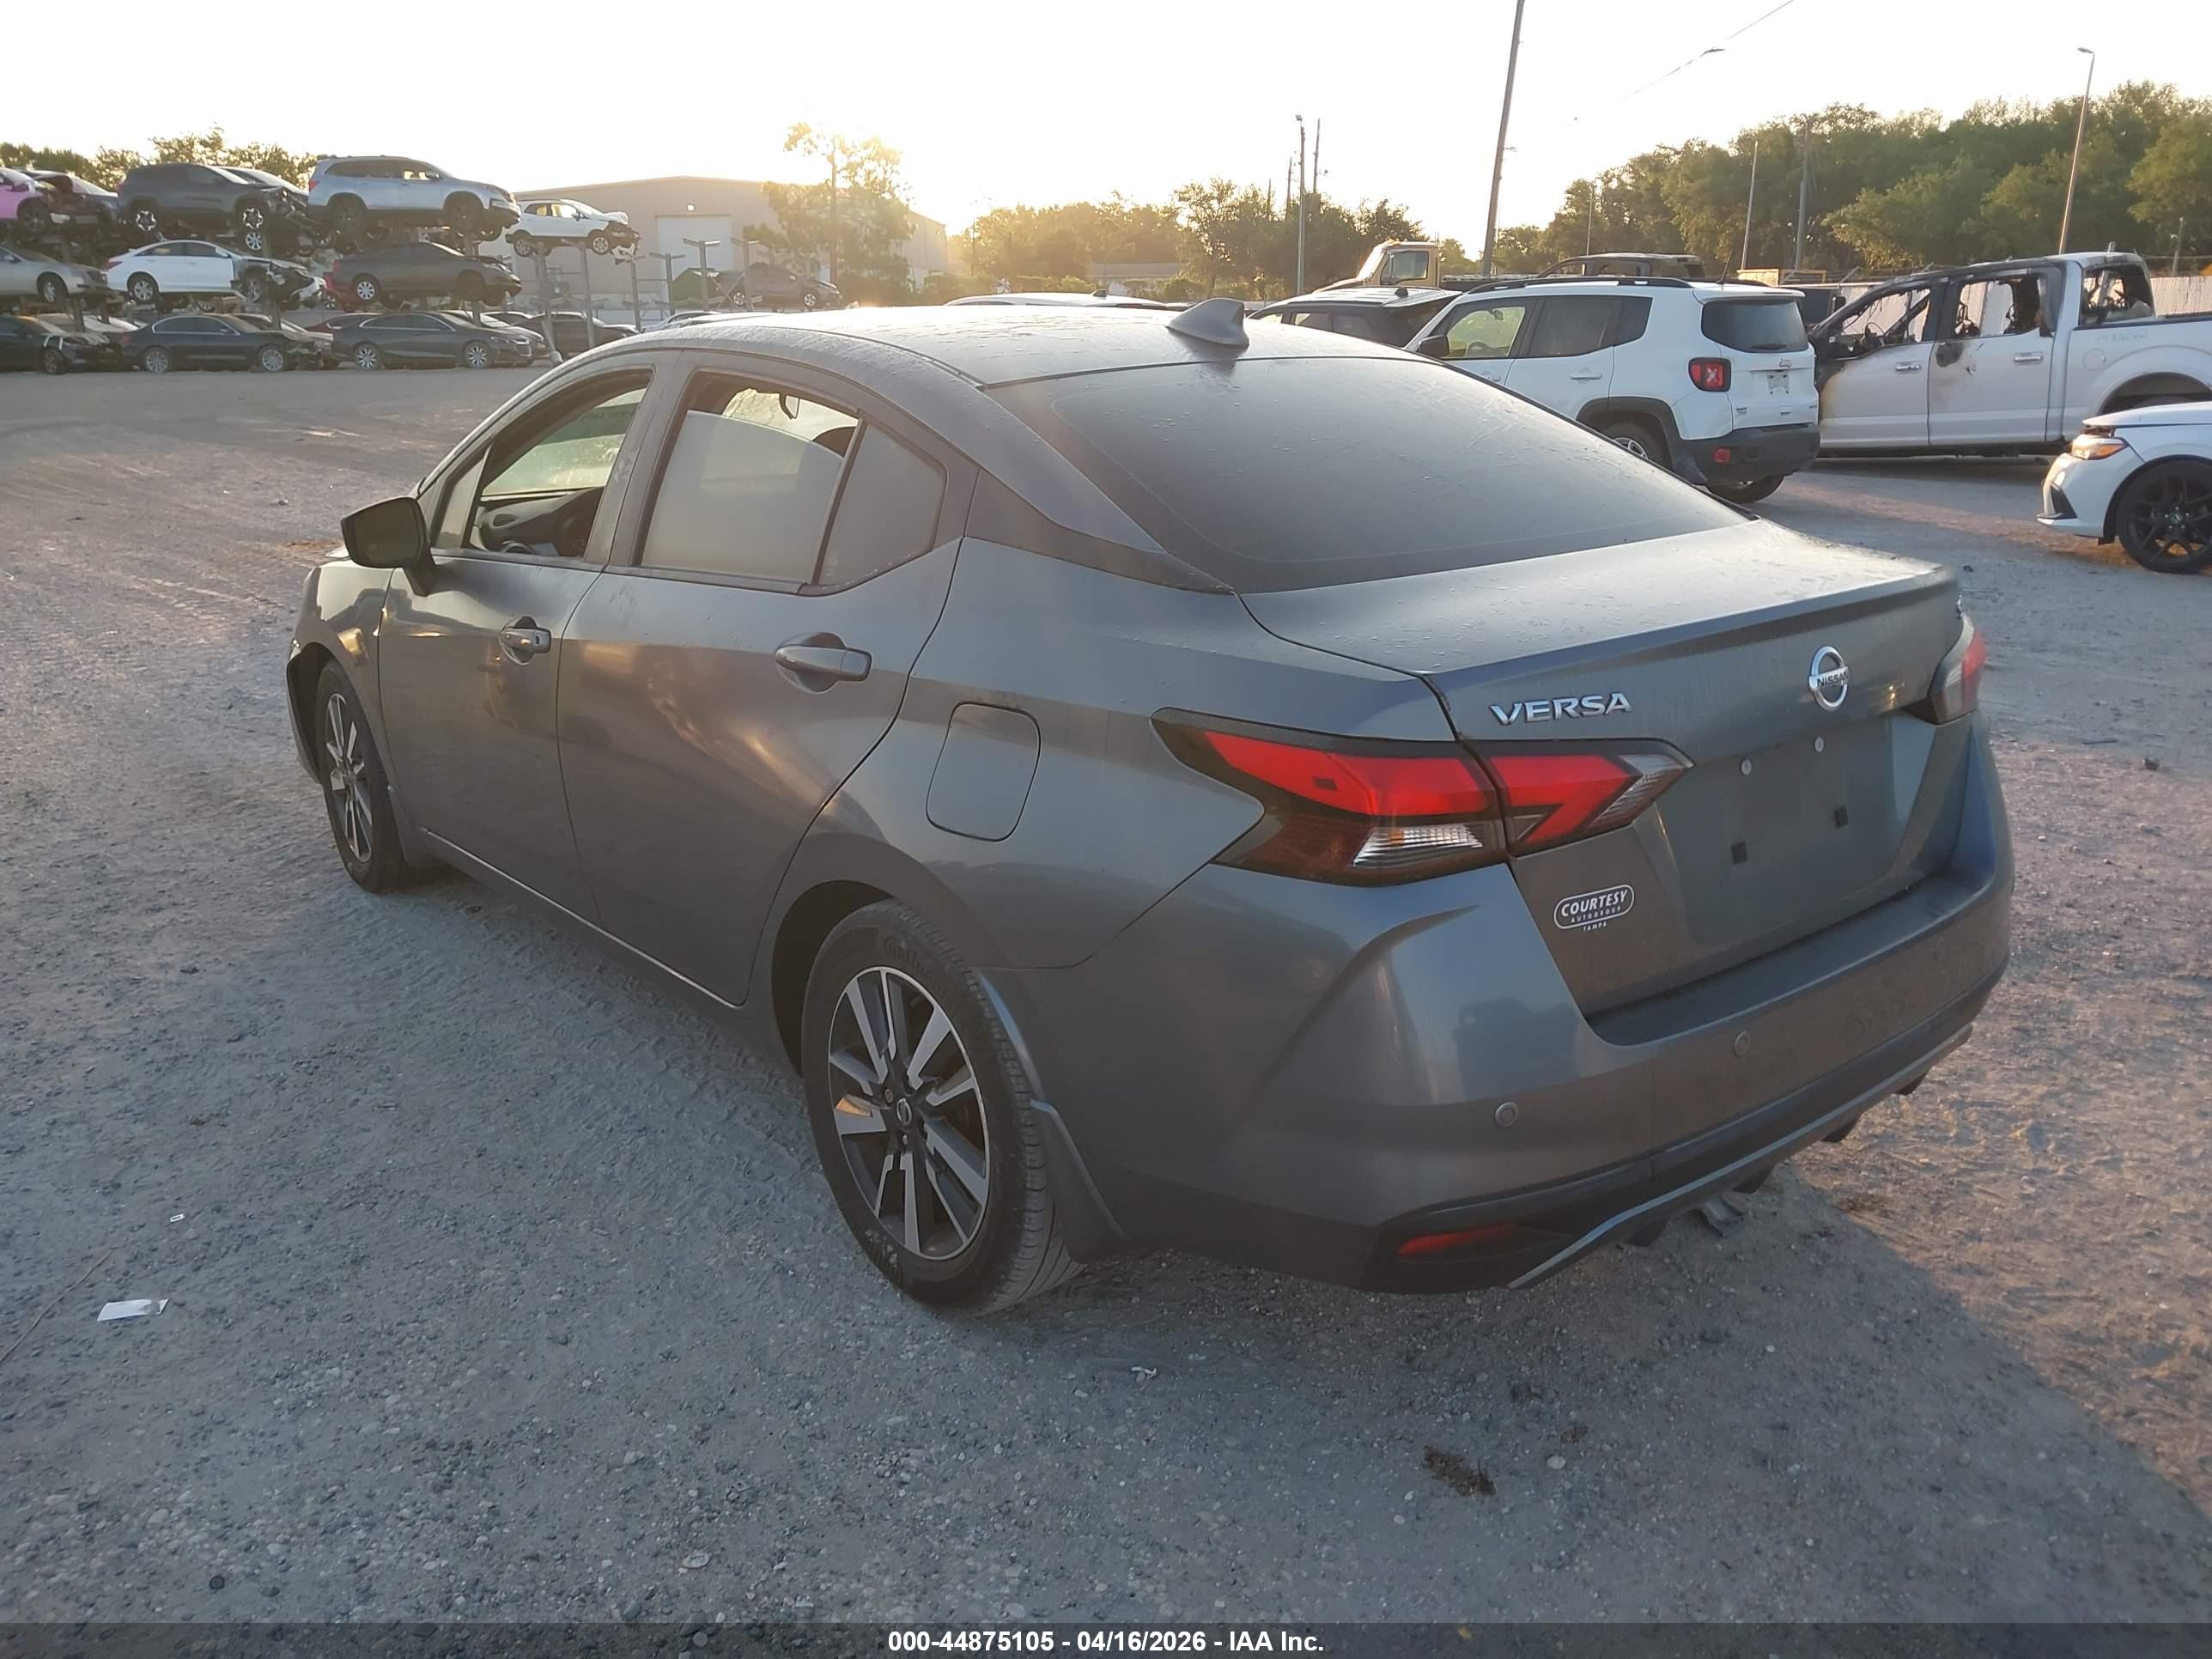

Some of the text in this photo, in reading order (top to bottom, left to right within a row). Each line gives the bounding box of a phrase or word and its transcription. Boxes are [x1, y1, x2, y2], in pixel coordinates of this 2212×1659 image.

[1490, 692, 1632, 725] VERSA
[1561, 889, 1628, 917] COURTESY
[1571, 906, 1621, 923] AUTOGROUP
[1583, 921, 1607, 932] TAMPA
